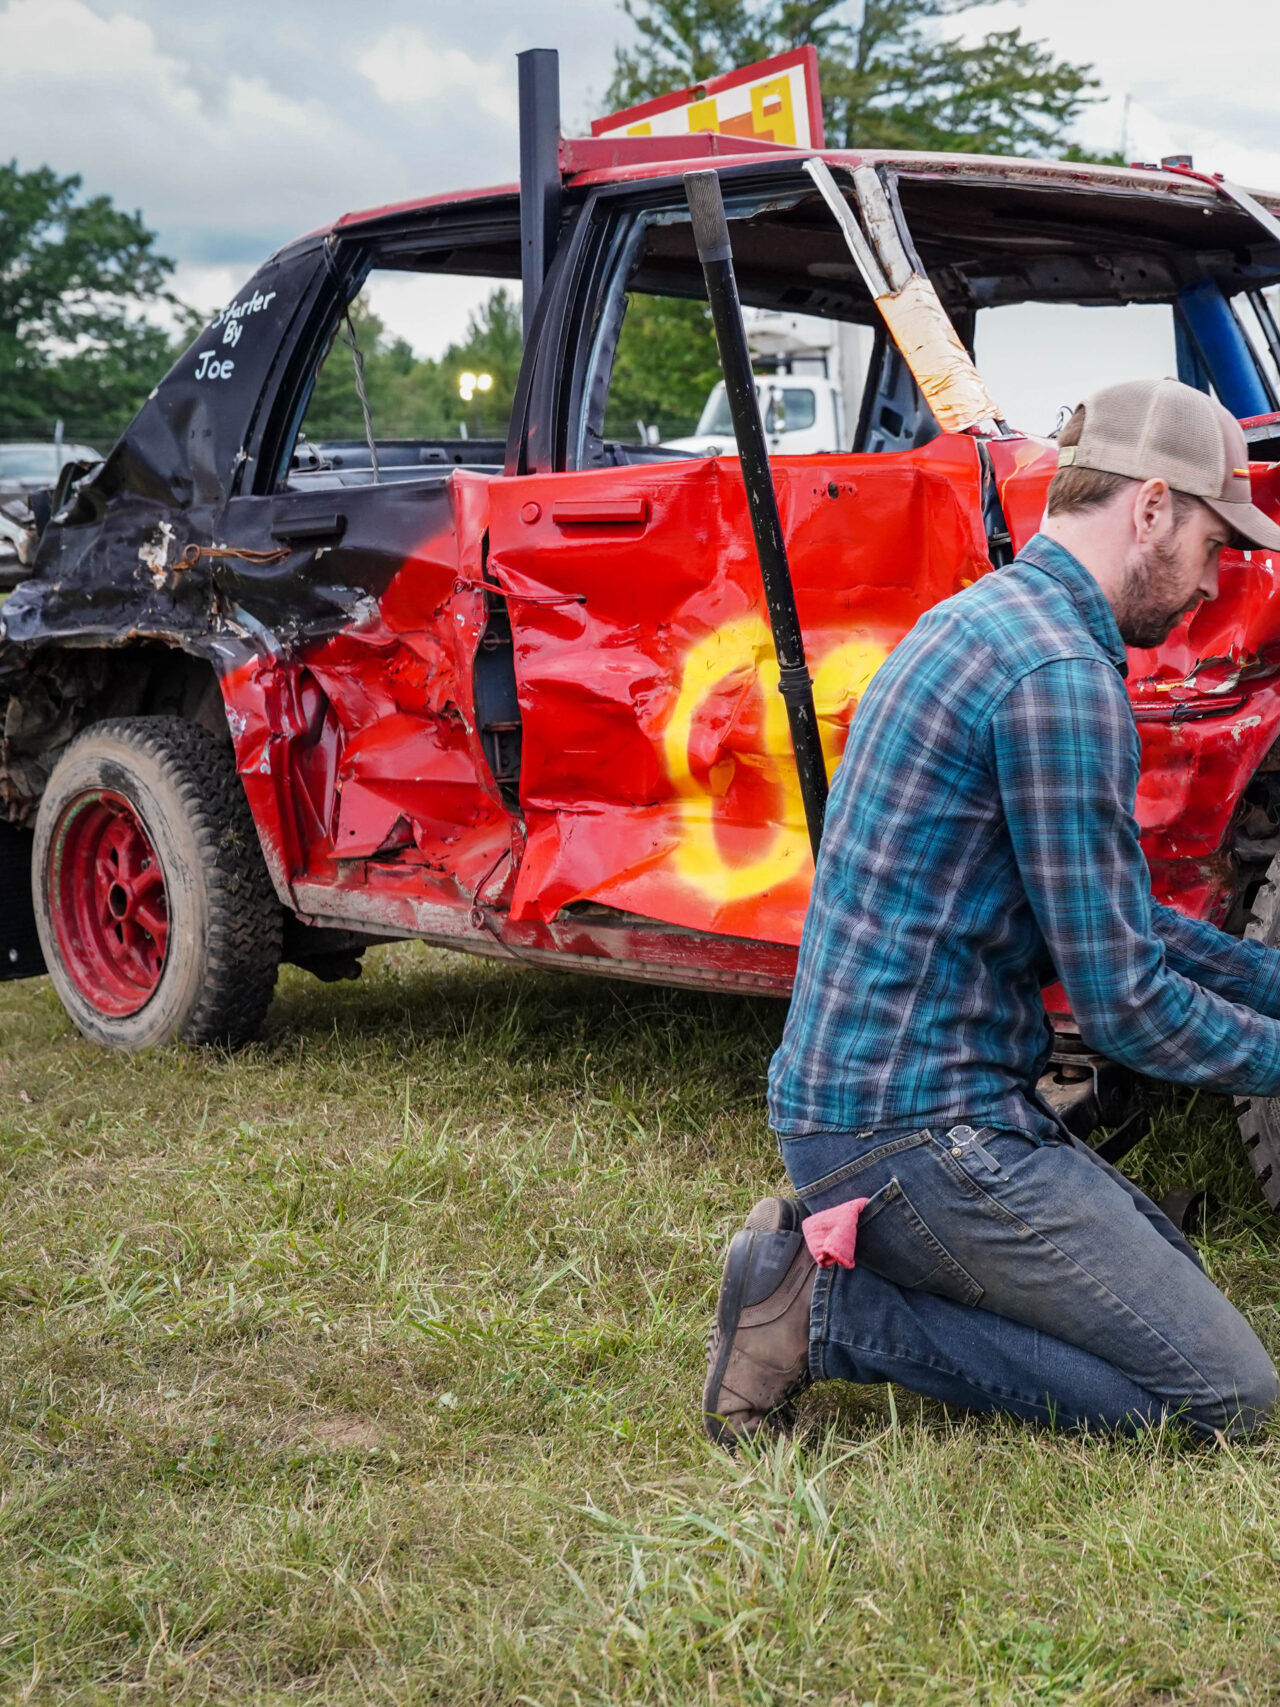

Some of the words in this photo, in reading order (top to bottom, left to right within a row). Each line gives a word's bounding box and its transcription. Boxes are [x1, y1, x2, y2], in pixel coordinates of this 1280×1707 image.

[212, 290, 276, 329] Starter
[222, 319, 243, 348] By
[195, 350, 234, 380] Joe
